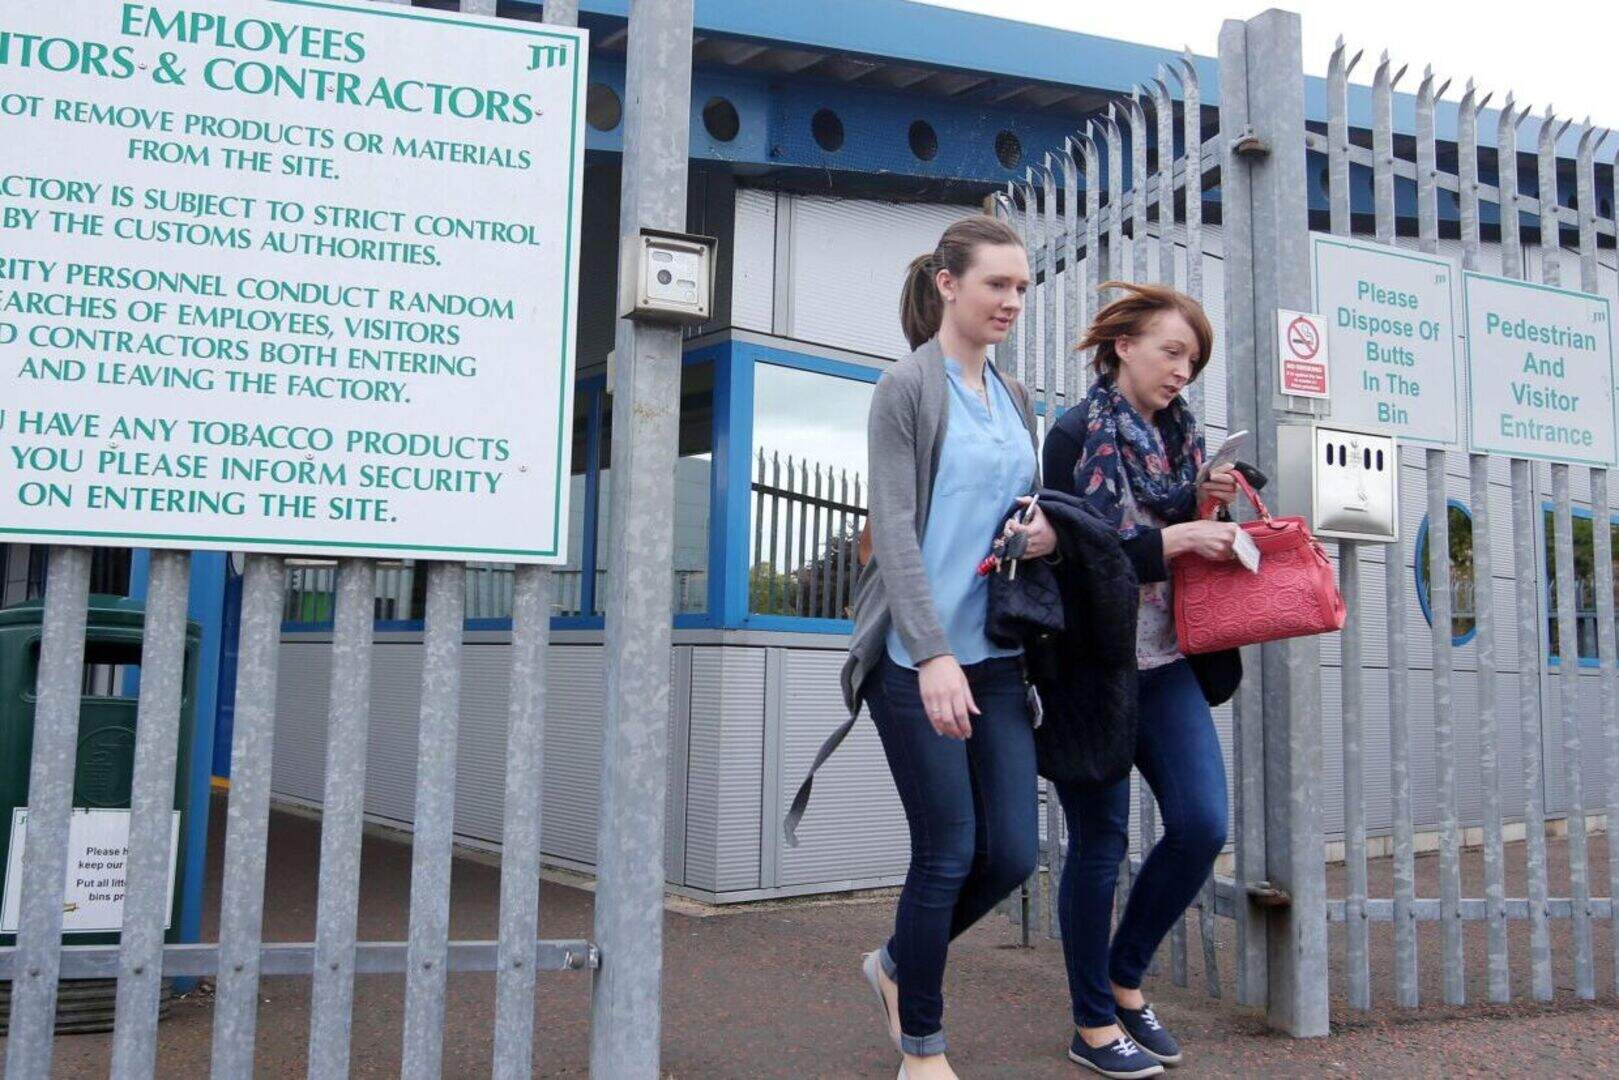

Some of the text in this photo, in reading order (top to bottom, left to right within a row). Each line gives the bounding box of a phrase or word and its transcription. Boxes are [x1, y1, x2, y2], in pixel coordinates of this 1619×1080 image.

[121, 3, 365, 63] EMPLOYEES
[0, 31, 533, 124] ITORS & CONTRACTORS
[1, 94, 530, 169] OT REMOVE PRODUCTS OR MATERIALS
[129, 139, 339, 179] FROM THE SITE.
[0, 176, 539, 245] CTORY IS SUBJECT TO STRICT CONTROL
[3, 207, 441, 266] BY THE CUSTOMS AUTHORITIES.
[66, 264, 227, 296] PERSONNEL
[237, 278, 379, 308] CONDUCT
[390, 291, 513, 319] RANDOM
[1358, 280, 1418, 310] Please
[0, 290, 460, 345] ARCHES OF EMPLOYEES, VISITORS
[1338, 306, 1440, 341] Dispose Of
[1487, 312, 1596, 351] Pedestrian
[29, 325, 248, 361] CONTRACTORS
[261, 342, 336, 367] BOTH
[348, 348, 476, 376] ENTERING
[1367, 341, 1415, 367] Butts
[1523, 351, 1565, 379] And
[18, 357, 410, 403] AND LEAVING THE FACTORY.
[1363, 370, 1420, 398] In The
[1511, 381, 1579, 413] Visitor
[1378, 401, 1408, 424] Bin
[1500, 413, 1593, 447] Entrance
[19, 411, 99, 437] HAVE
[109, 416, 178, 442] ANY
[188, 421, 333, 451] TOBACCO
[347, 431, 509, 461] PRODUCTS
[11, 446, 502, 493] YOU PLEASE INFORM SECURITY
[18, 482, 396, 522] ON ENTERING THE SITE.
[78, 860, 104, 871] keep
[86, 846, 129, 856] Please h
[76, 878, 128, 888] Put all litt
[89, 892, 125, 903] bins pr
